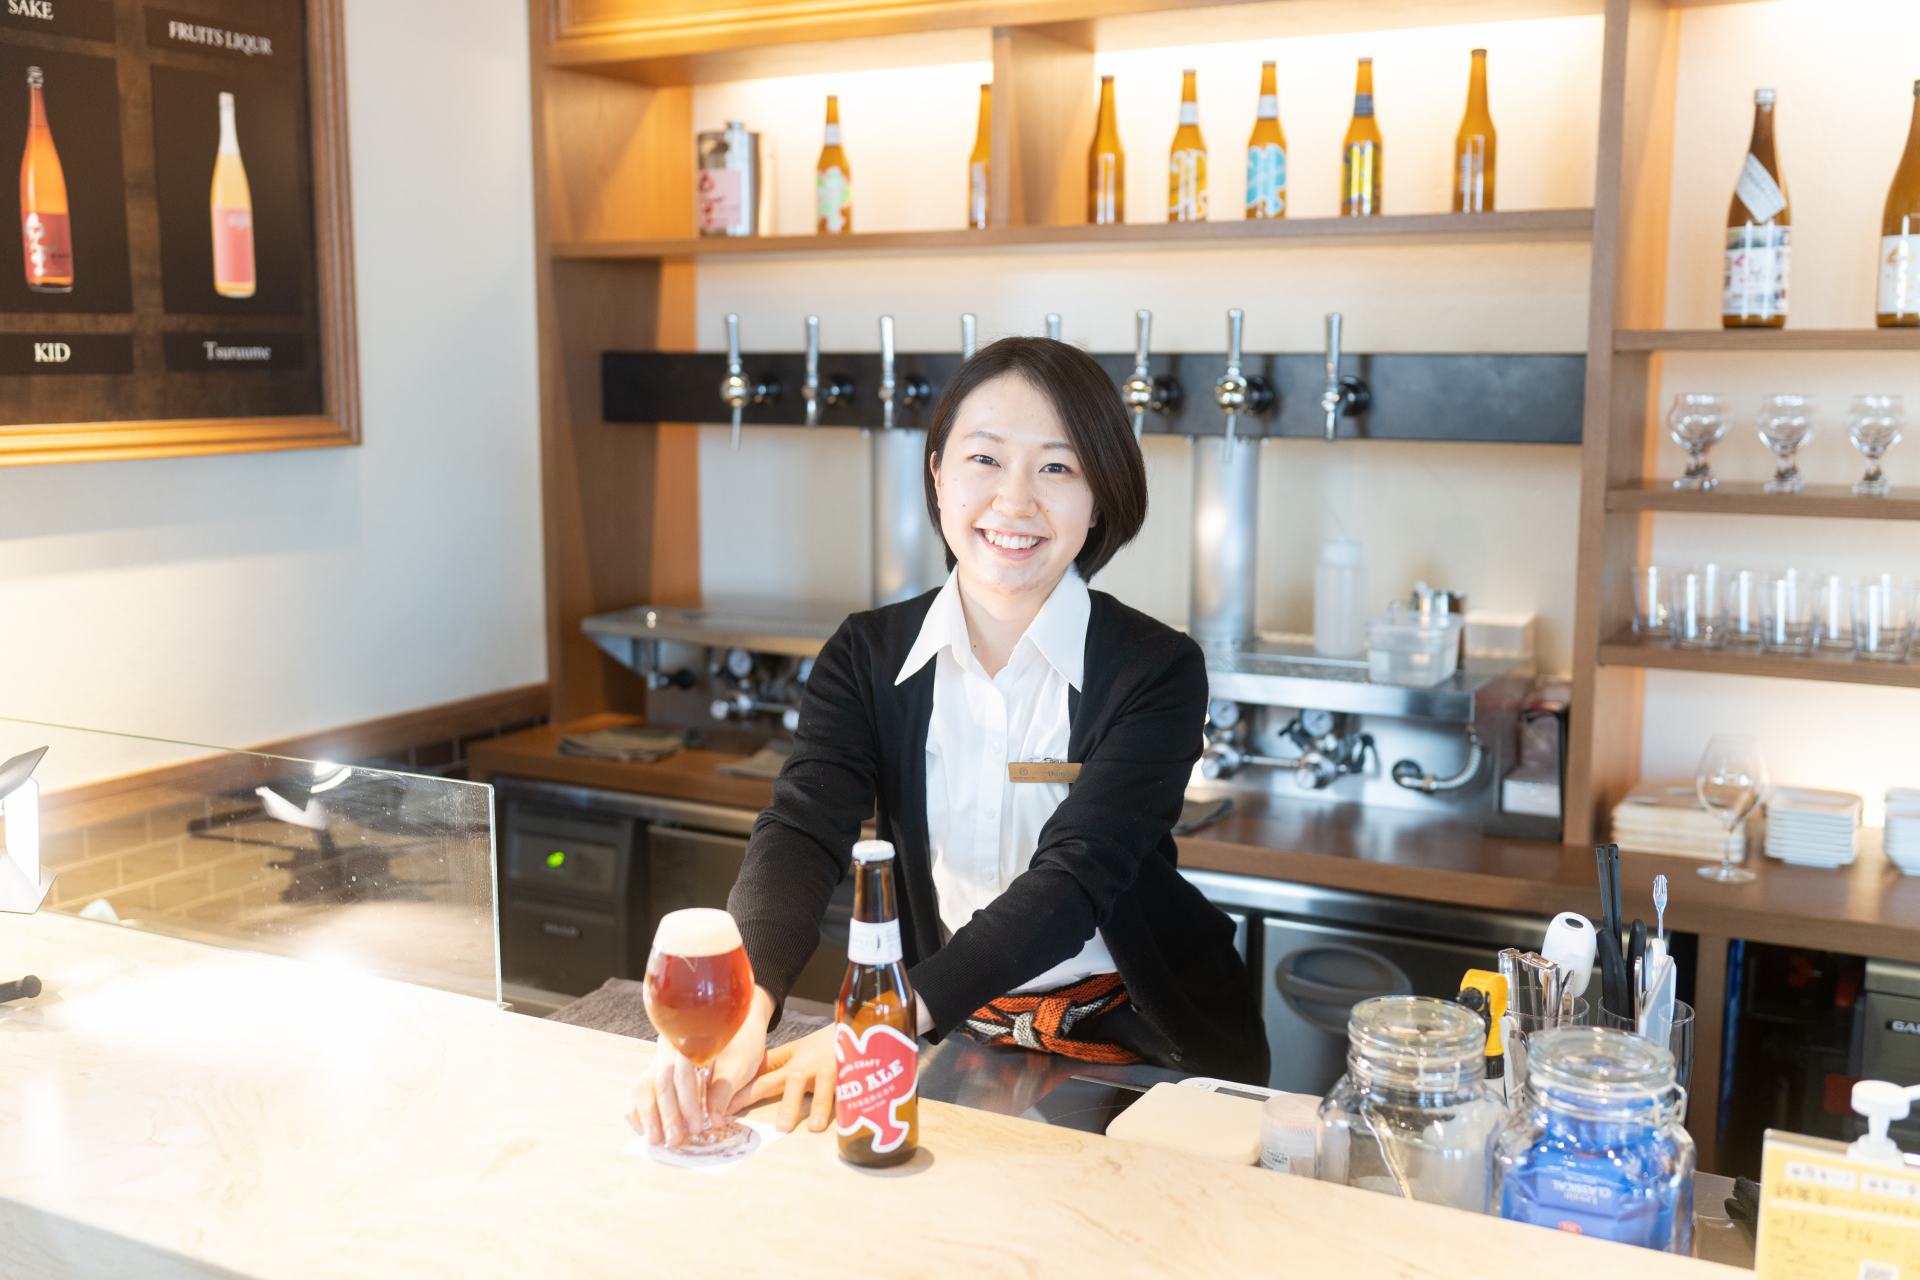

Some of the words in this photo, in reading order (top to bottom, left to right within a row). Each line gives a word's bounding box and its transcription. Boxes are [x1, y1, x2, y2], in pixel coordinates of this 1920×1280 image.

[7, 0, 54, 21] SAKE
[168, 20, 224, 47] FRUITS
[34, 342, 71, 363] KID
[865, 1058, 905, 1092] ALE
